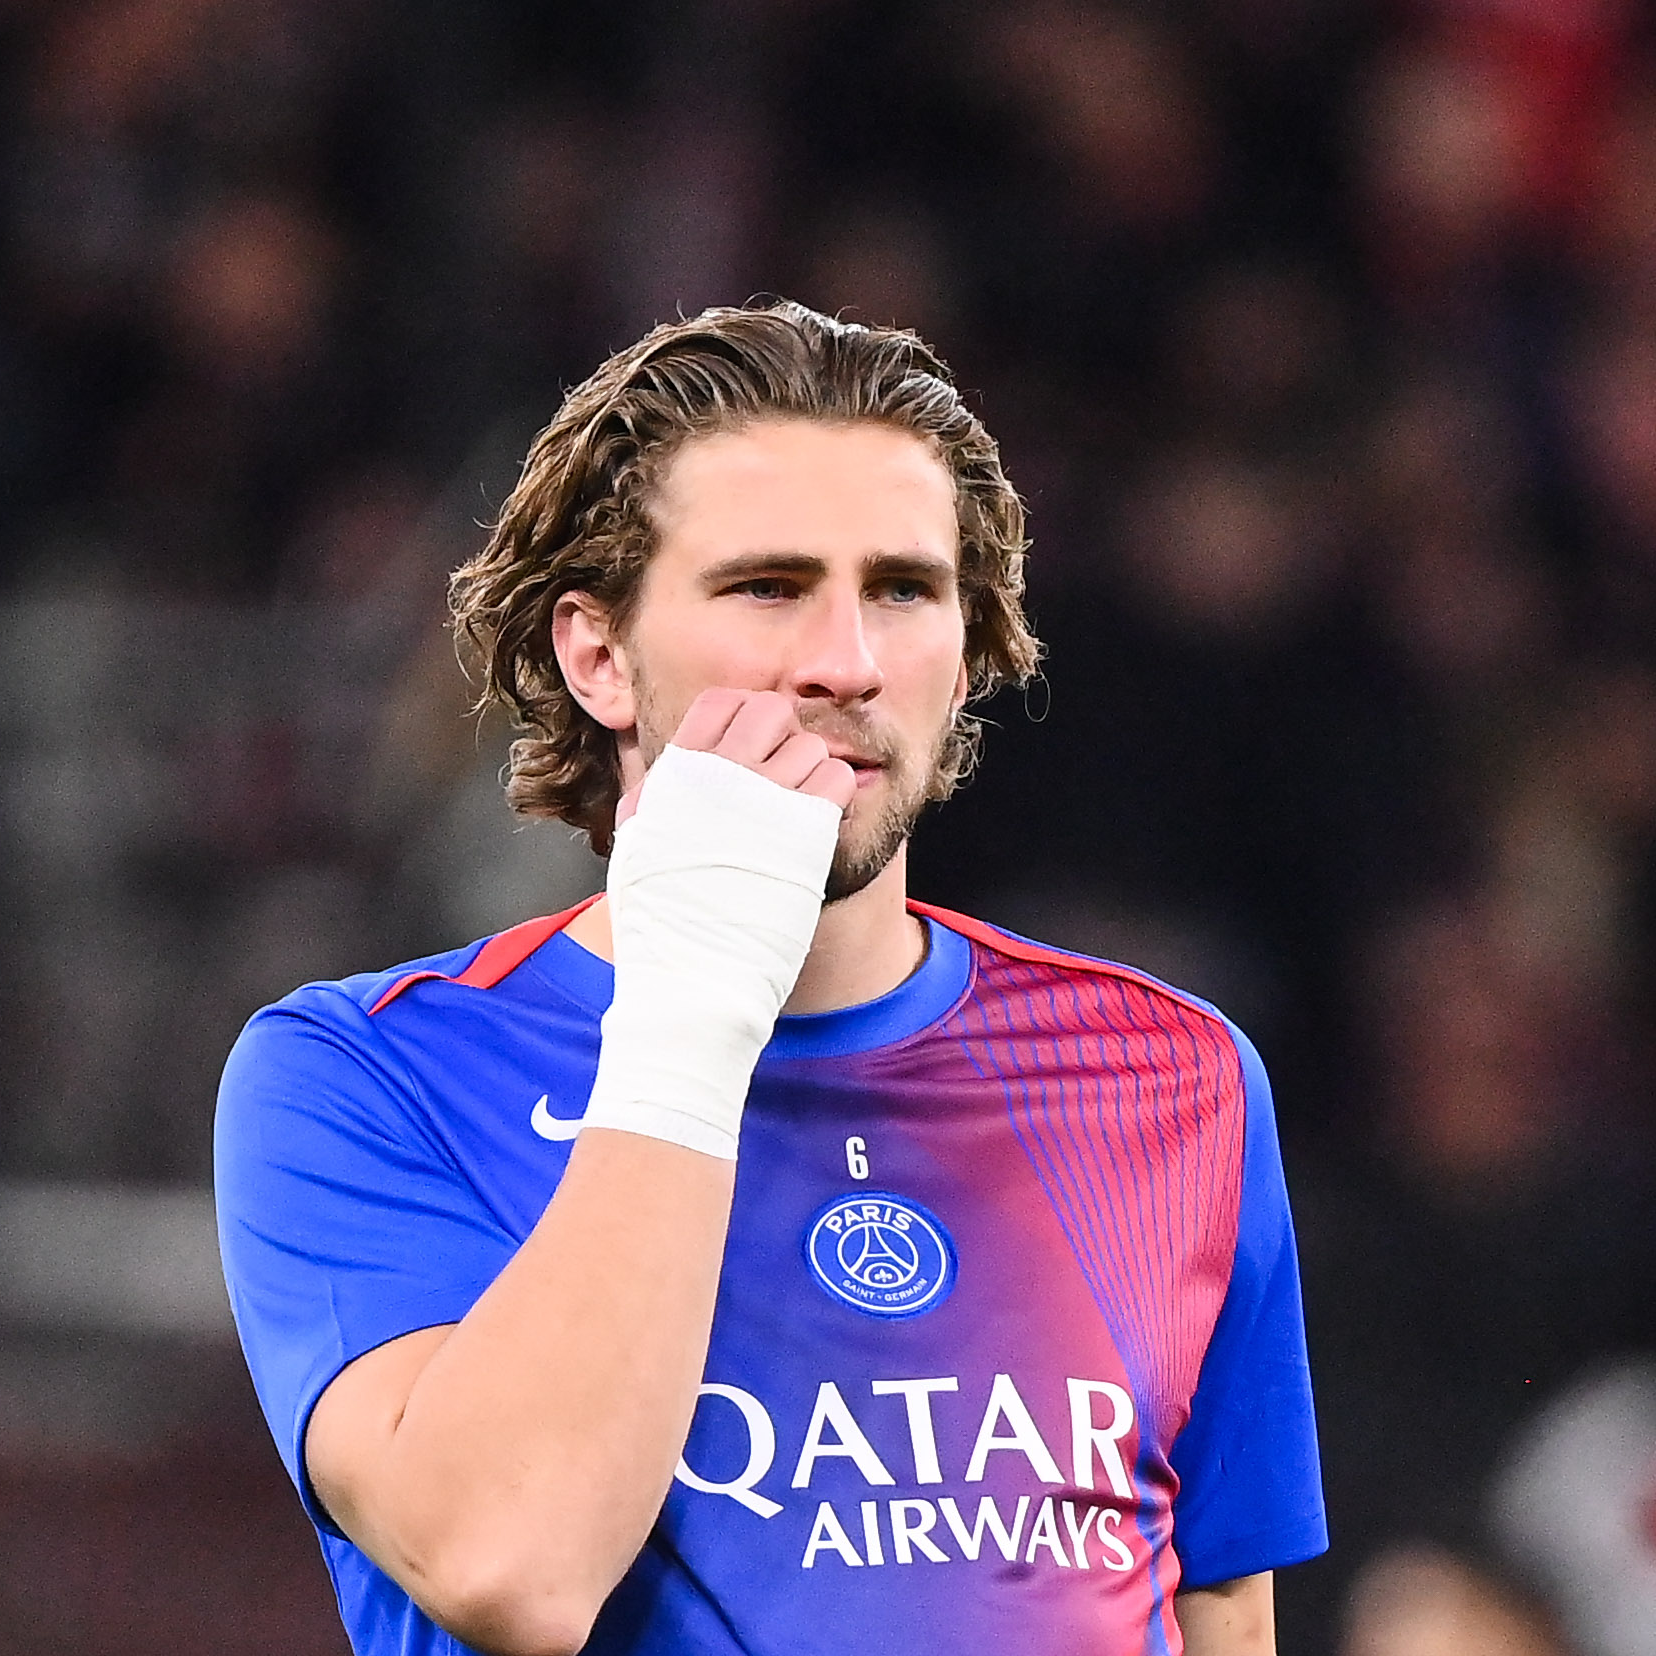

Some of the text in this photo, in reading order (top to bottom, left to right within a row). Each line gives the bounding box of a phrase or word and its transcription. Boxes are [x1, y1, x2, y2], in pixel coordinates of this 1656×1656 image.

[845, 1135, 870, 1180] 6
[825, 1205, 914, 1234] PARIS
[673, 1373, 1135, 1519] QATAR
[801, 1496, 1135, 1571] AIRWAYS
